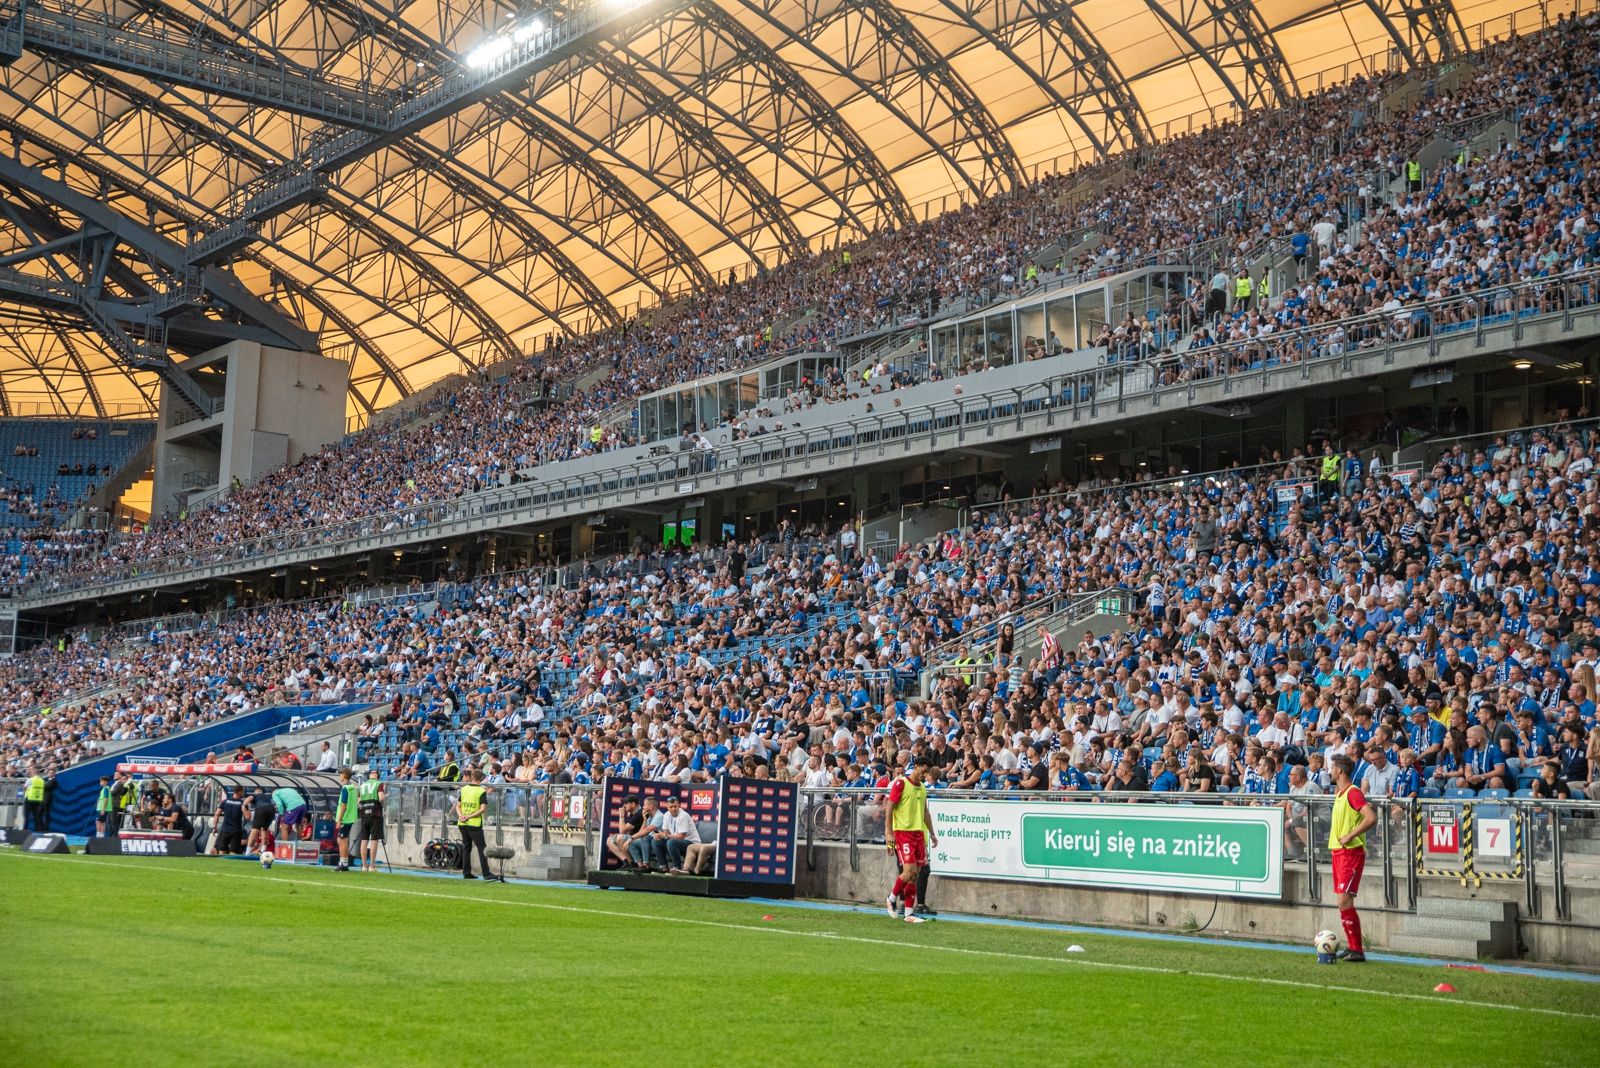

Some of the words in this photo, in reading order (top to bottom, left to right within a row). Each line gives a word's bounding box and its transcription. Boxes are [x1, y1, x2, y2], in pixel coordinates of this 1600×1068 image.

[360, 783, 377, 795] TV
[694, 794, 712, 805] Duda
[554, 800, 563, 813] M
[574, 801, 580, 814] 6
[937, 813, 959, 823] Masz
[961, 813, 991, 824] Poznań
[937, 829, 945, 837] w
[947, 829, 989, 841] deklaracji
[991, 830, 1012, 840] PIT?
[1433, 826, 1453, 847] M
[1487, 828, 1500, 848] 7
[902, 843, 911, 854] 5
[1045, 829, 1100, 857] Kieruj
[1107, 831, 1136, 859] się
[1142, 837, 1167, 855] na
[1172, 834, 1241, 865] zniżkę
